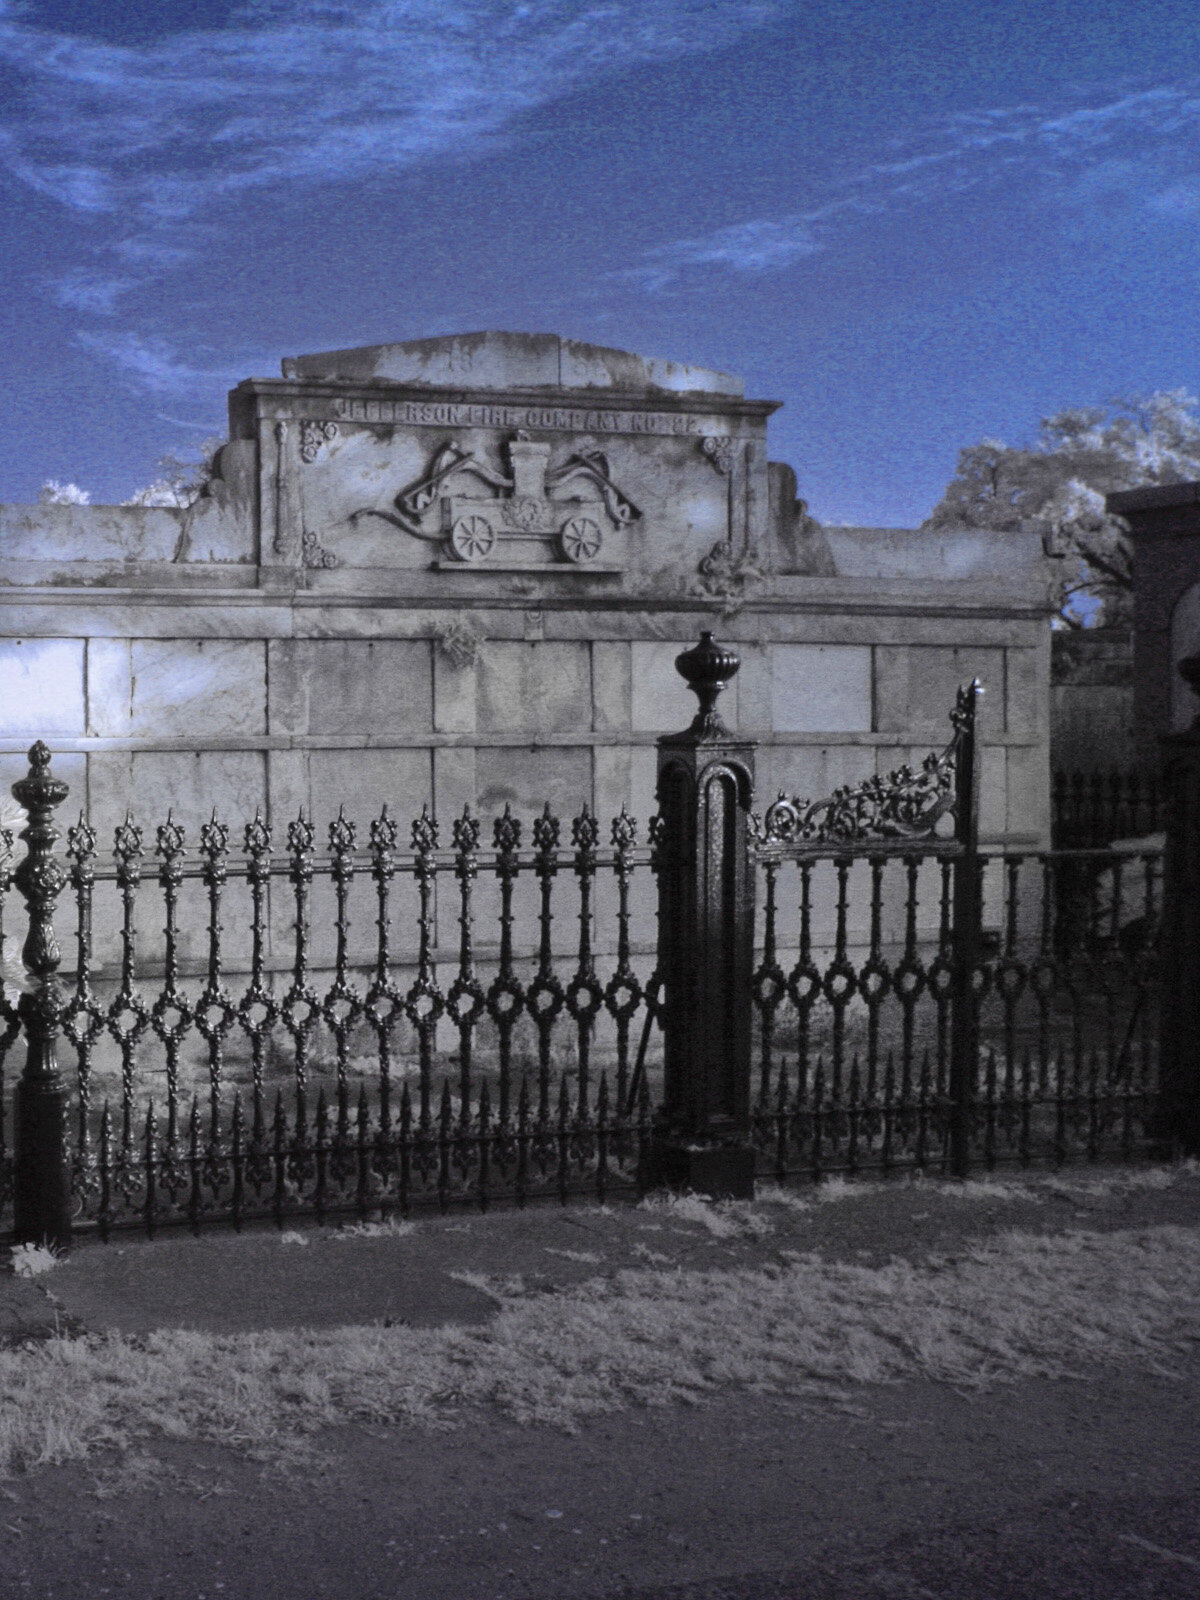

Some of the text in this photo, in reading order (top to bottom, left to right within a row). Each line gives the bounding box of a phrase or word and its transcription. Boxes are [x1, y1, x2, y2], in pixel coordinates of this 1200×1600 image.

[335, 398, 460, 425] JEFFERSON
[468, 406, 516, 428] FIRE
[526, 410, 619, 431] COMPANY
